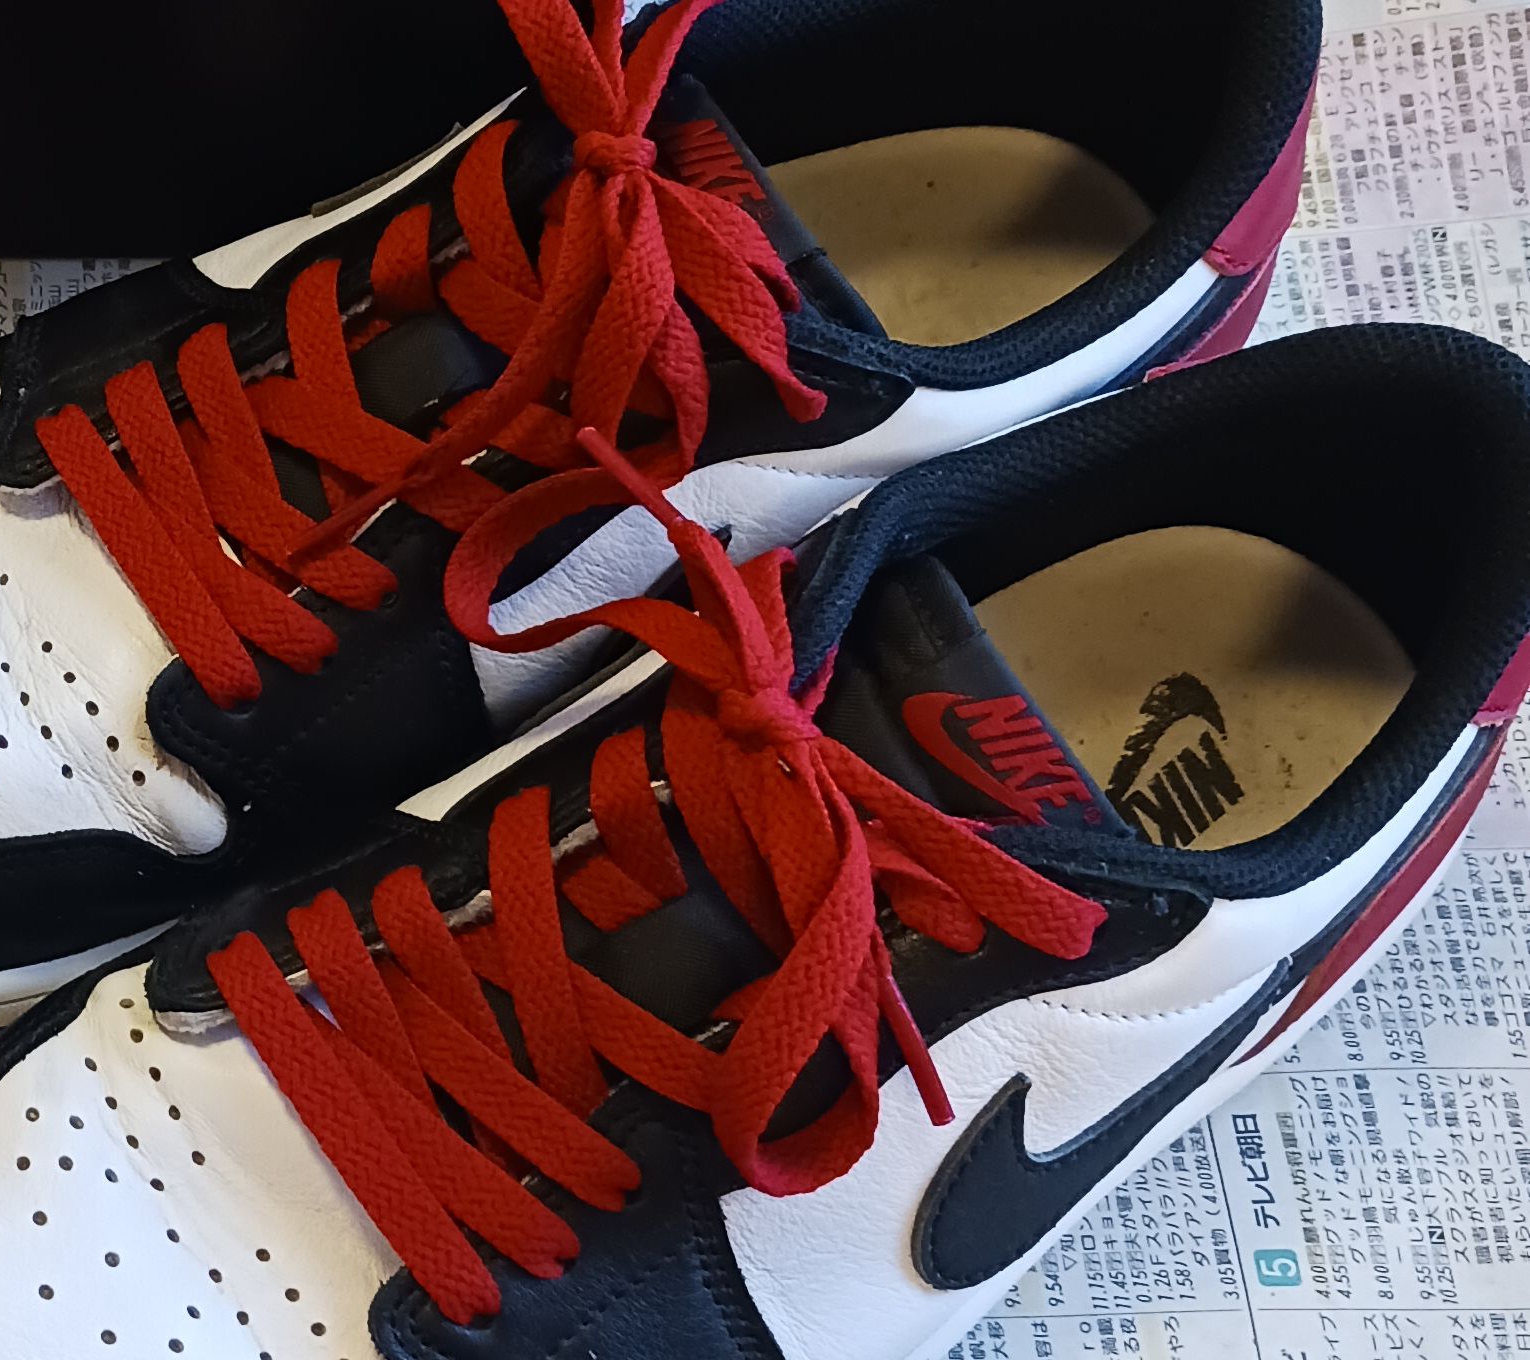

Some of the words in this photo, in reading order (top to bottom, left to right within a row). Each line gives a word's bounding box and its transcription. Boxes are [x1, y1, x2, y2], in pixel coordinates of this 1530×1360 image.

[954, 694, 1094, 826] NIKE
[1232, 1114, 1280, 1228] テレビ朝日
